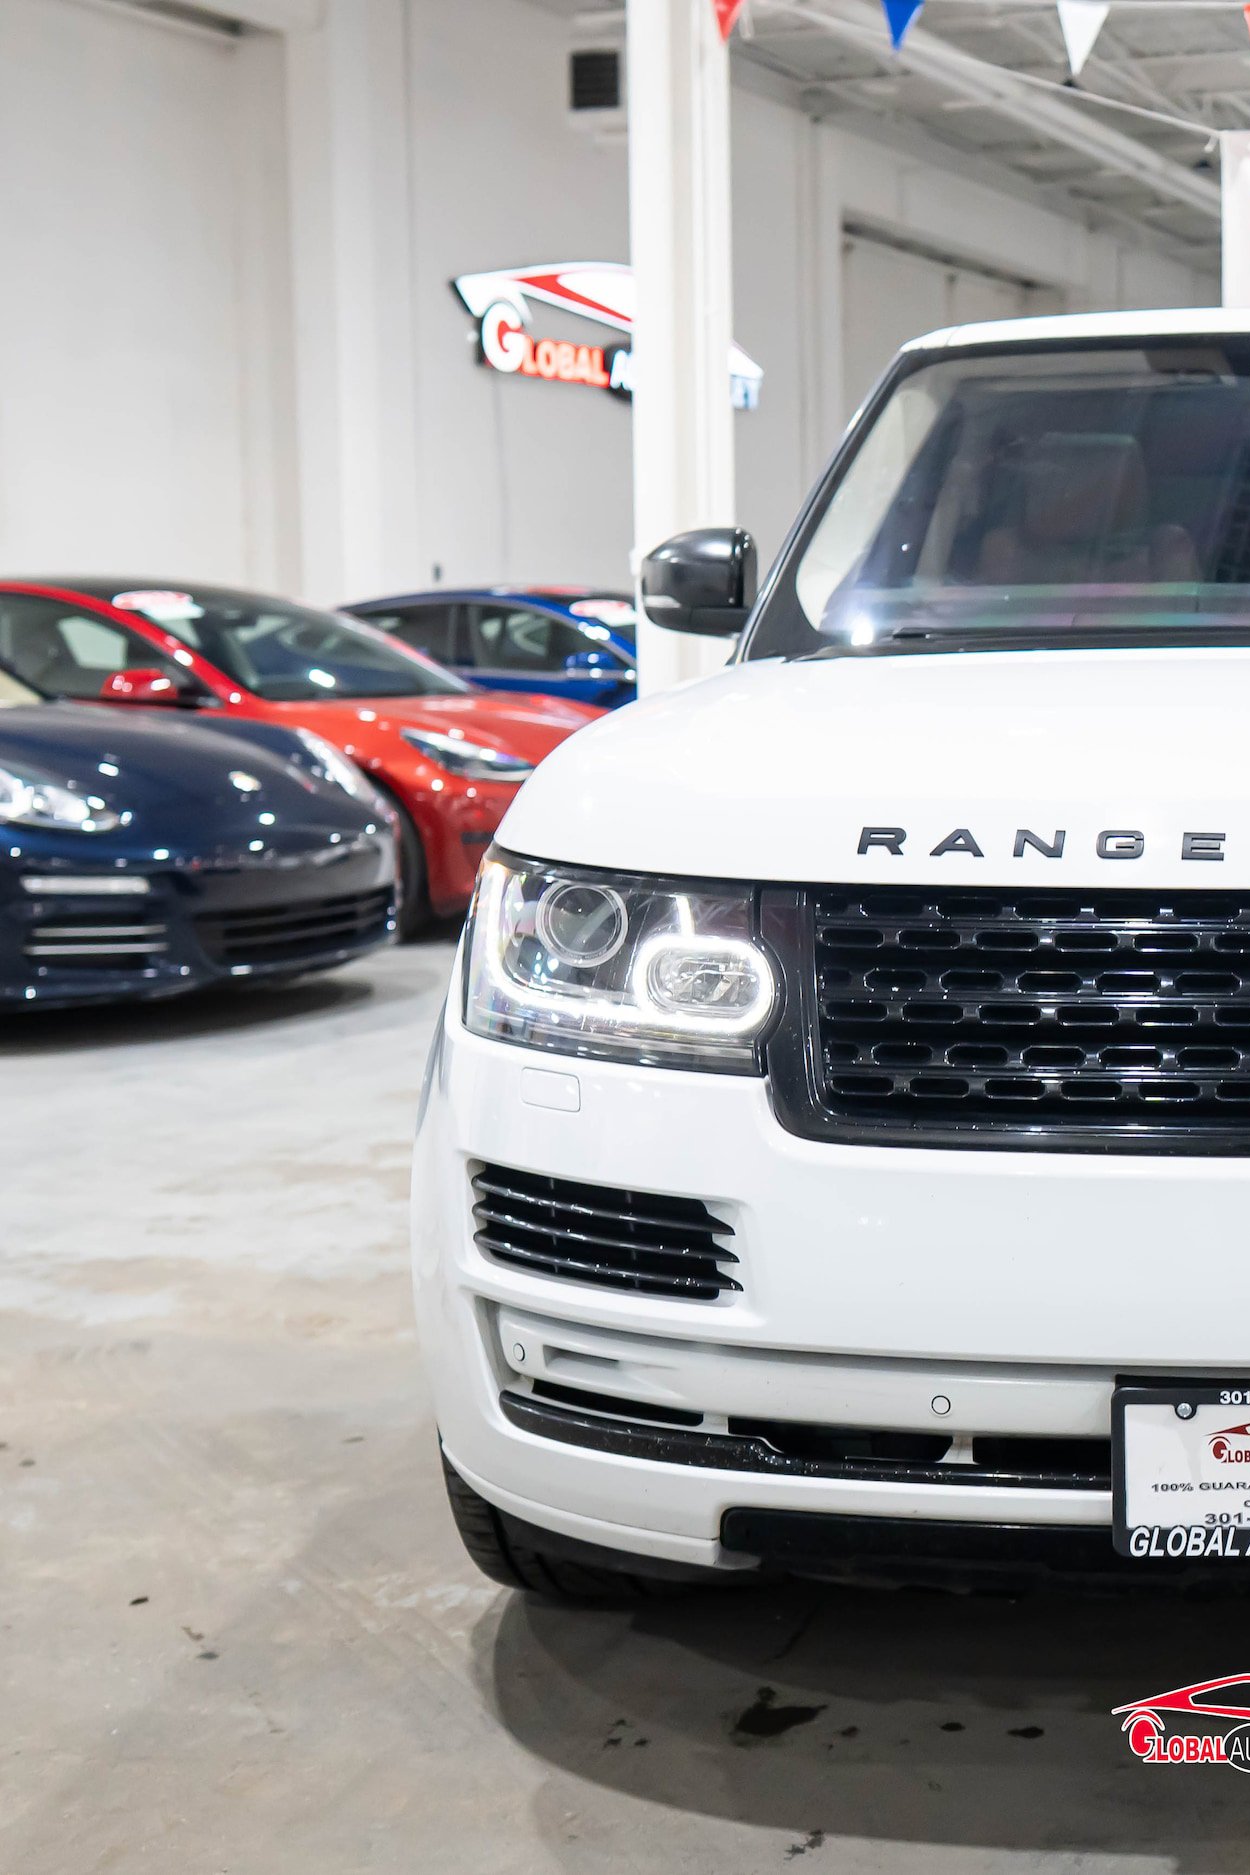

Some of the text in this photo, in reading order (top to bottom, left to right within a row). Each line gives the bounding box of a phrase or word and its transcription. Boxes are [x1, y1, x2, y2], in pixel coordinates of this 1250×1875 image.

[481, 301, 610, 388] GLOBAL
[856, 826, 1226, 862] RANGE
[1151, 1482, 1194, 1493] 100%
[1129, 1525, 1243, 1558] GLOBAL
